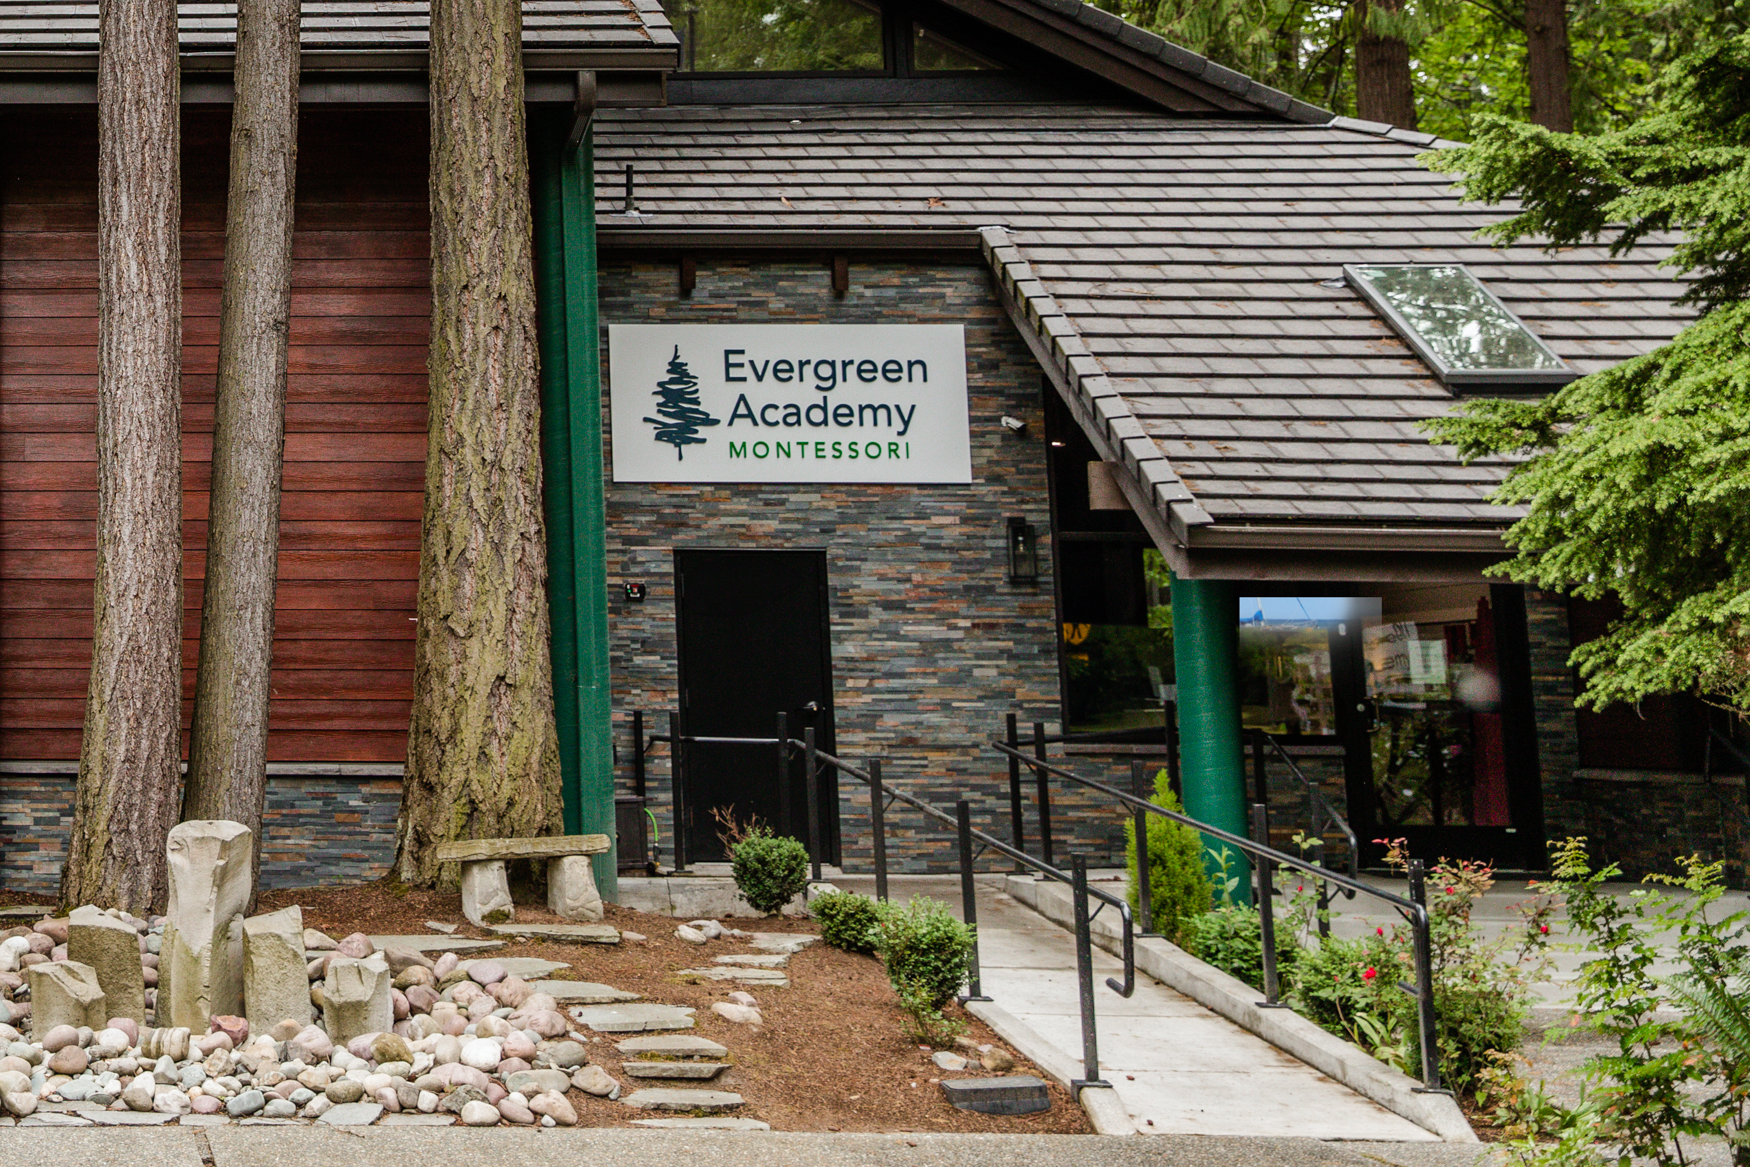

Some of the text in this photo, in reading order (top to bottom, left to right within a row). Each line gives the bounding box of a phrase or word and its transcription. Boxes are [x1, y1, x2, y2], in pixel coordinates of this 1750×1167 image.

[724, 349, 928, 392] Evergreen
[727, 393, 917, 437] Academy
[729, 440, 910, 460] MONTESSORI
